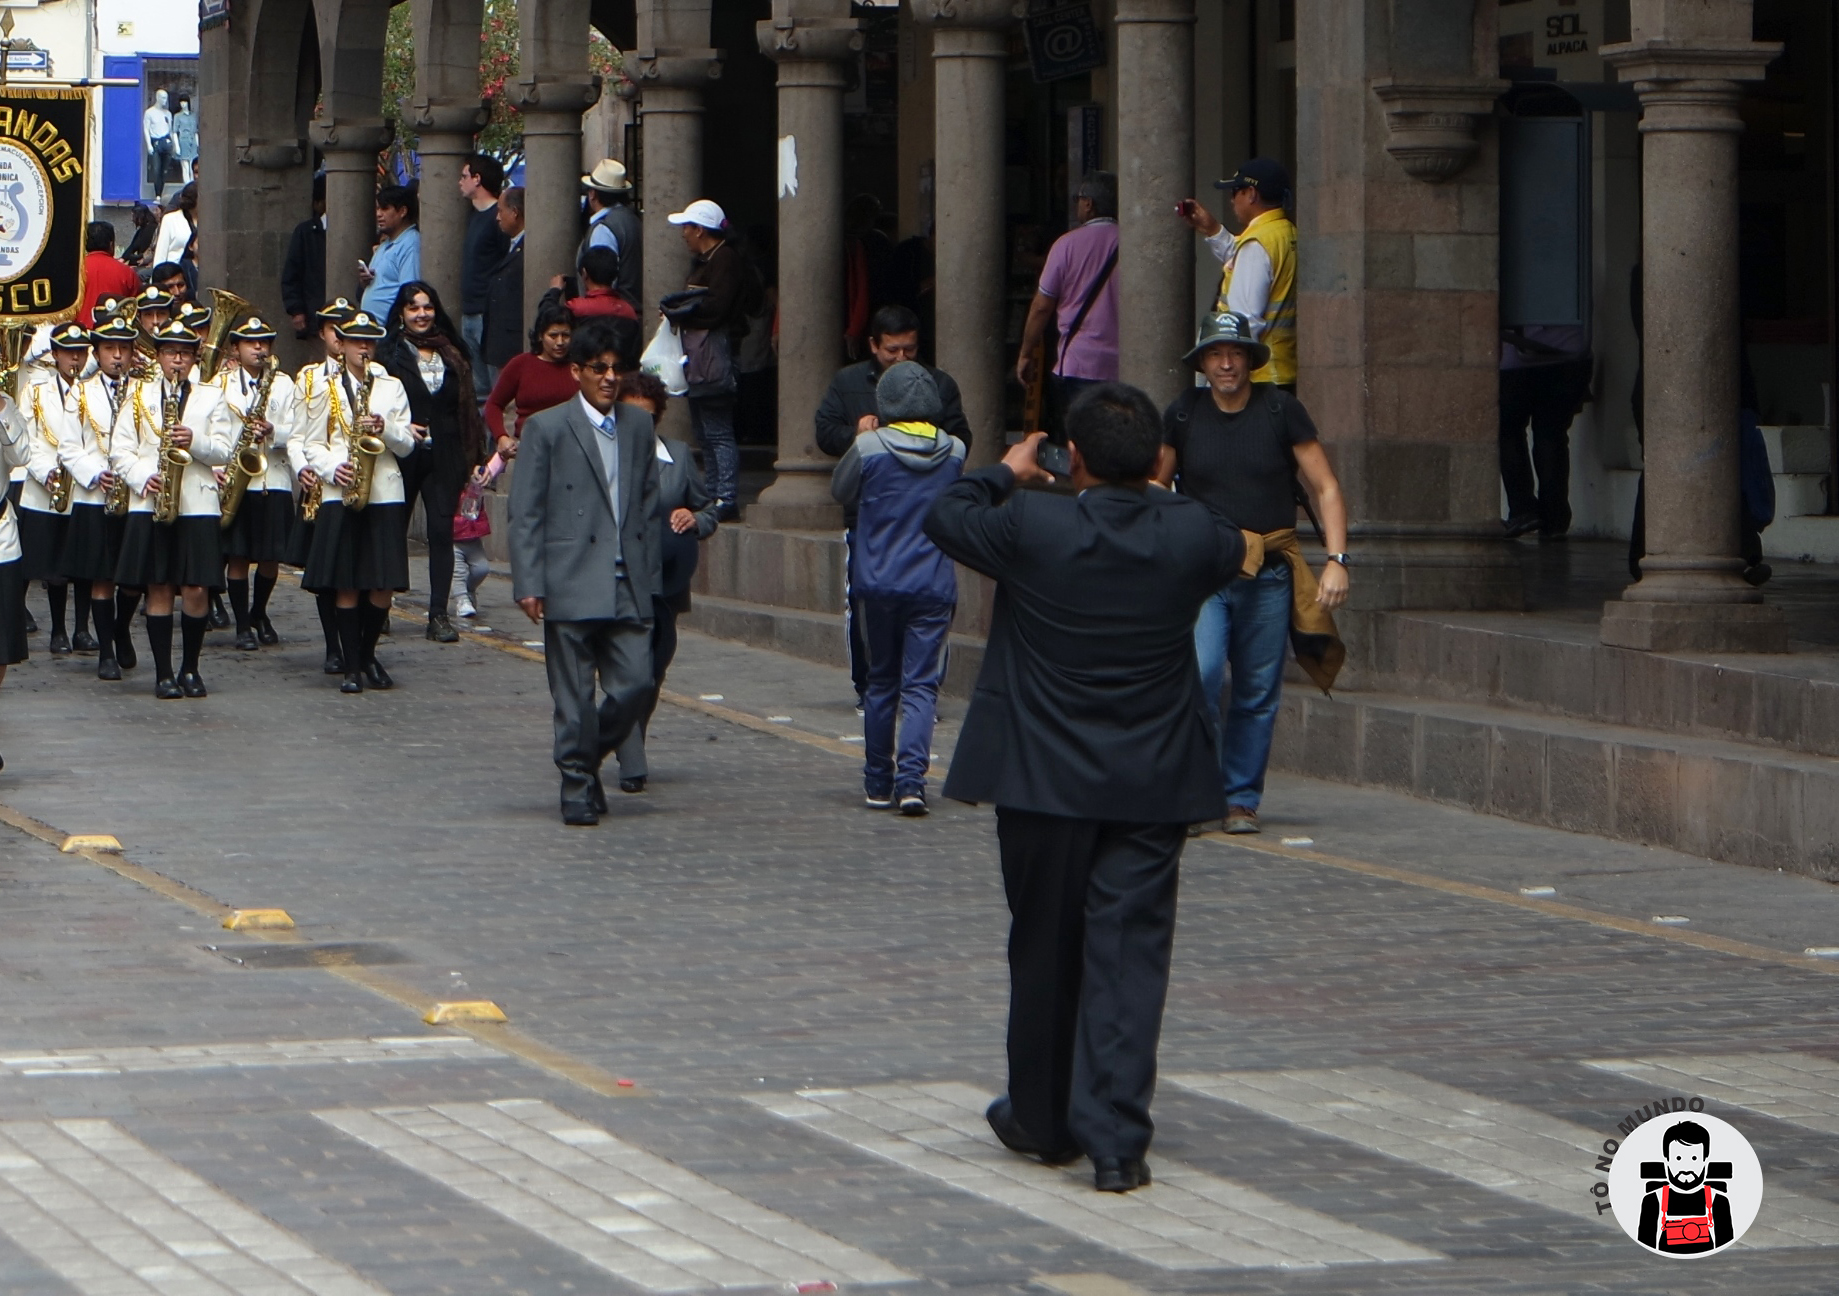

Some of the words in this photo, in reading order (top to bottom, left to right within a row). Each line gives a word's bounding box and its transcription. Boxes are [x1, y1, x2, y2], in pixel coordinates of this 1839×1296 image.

[1546, 14, 1588, 38] SOL
[1546, 40, 1588, 56] ALPACA
[31, 170, 45, 216] CONCEPCION
[0, 201, 14, 212] BIEN
